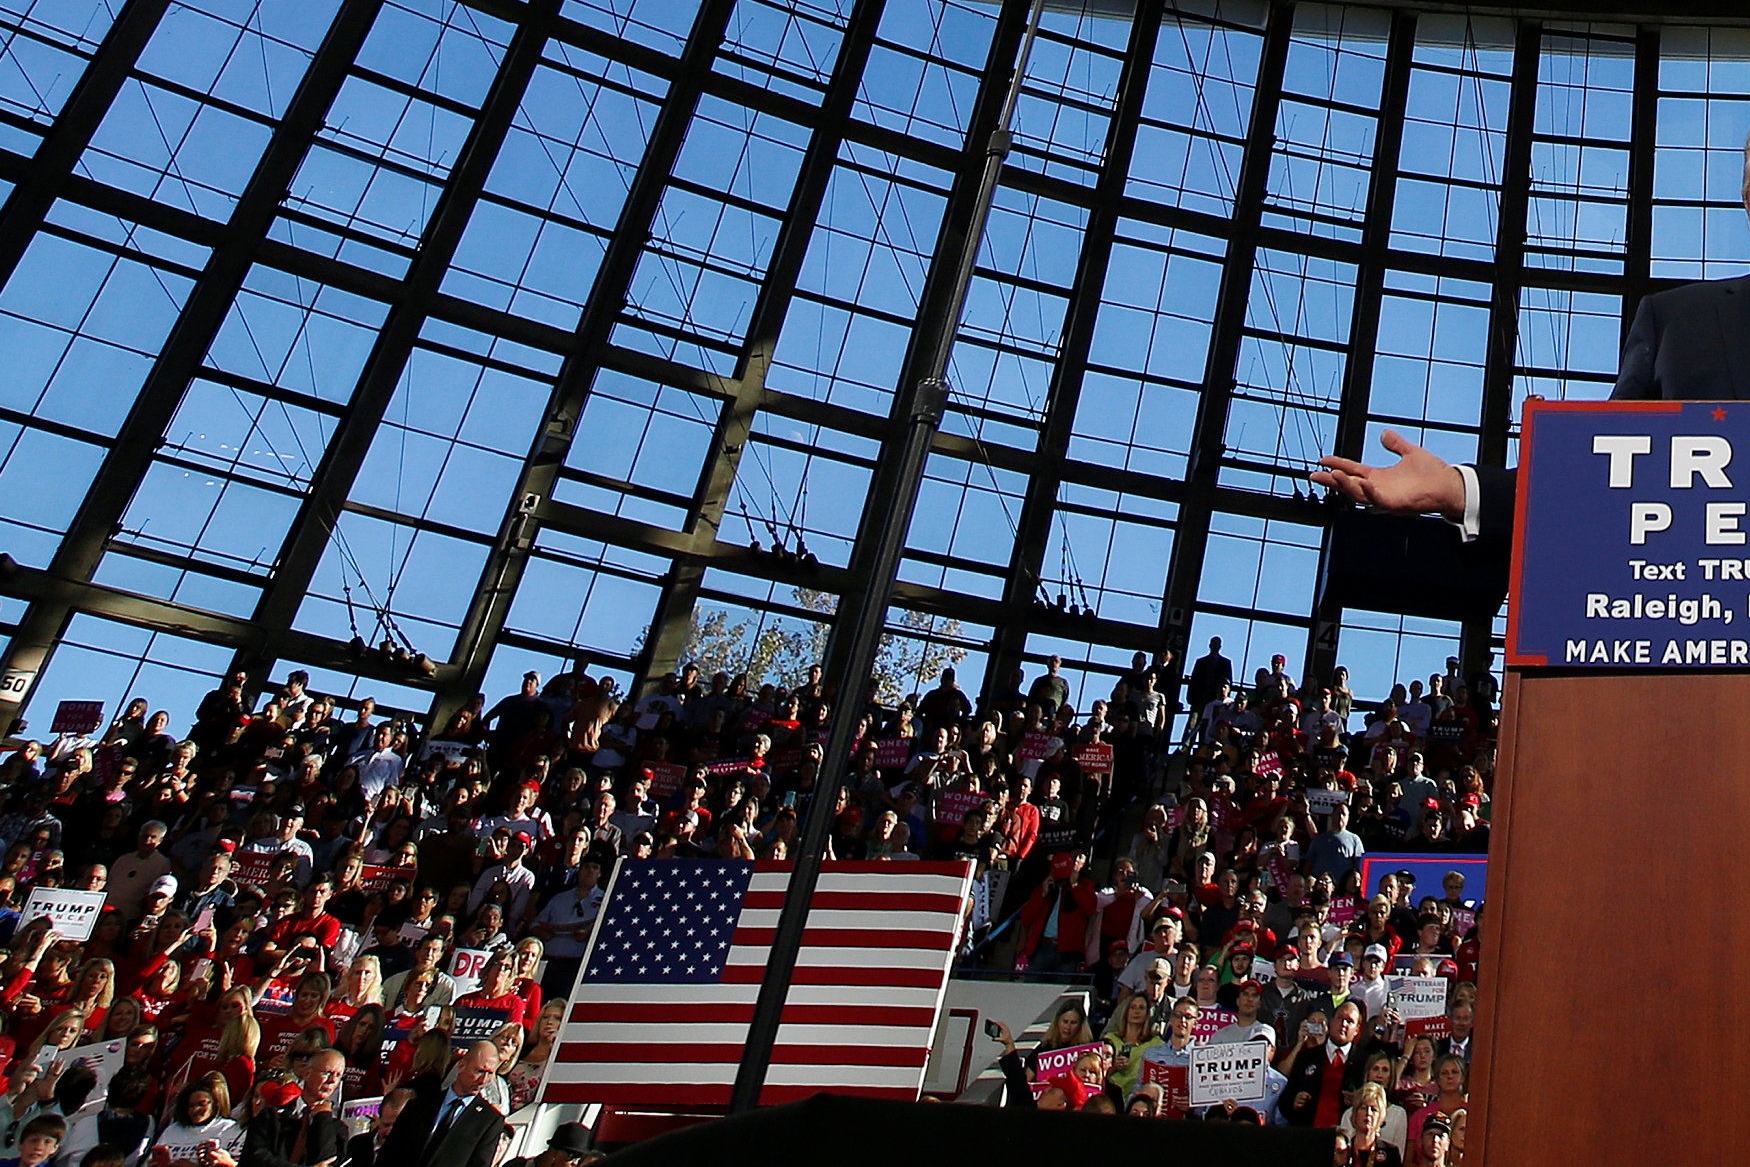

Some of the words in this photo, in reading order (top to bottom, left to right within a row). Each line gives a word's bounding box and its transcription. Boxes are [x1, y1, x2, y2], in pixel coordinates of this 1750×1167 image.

[1629, 560, 1686, 581] Text
[1586, 593, 1734, 625] Raleigh,
[1319, 624, 1338, 648] 4
[1565, 639, 1652, 664] MAKE
[0, 676, 26, 693] 50
[1078, 753, 1111, 762] MERICA
[31, 901, 96, 914] TRUMP
[1400, 993, 1445, 1003] TRUMP
[453, 1026, 494, 1036] ENCE
[1195, 1023, 1219, 1032] FOR
[1424, 1022, 1446, 1031] MAKE
[1038, 1046, 1103, 1071] WOMN
[1195, 1058, 1262, 1073] TRUMP
[1201, 1071, 1256, 1082] PENCE
